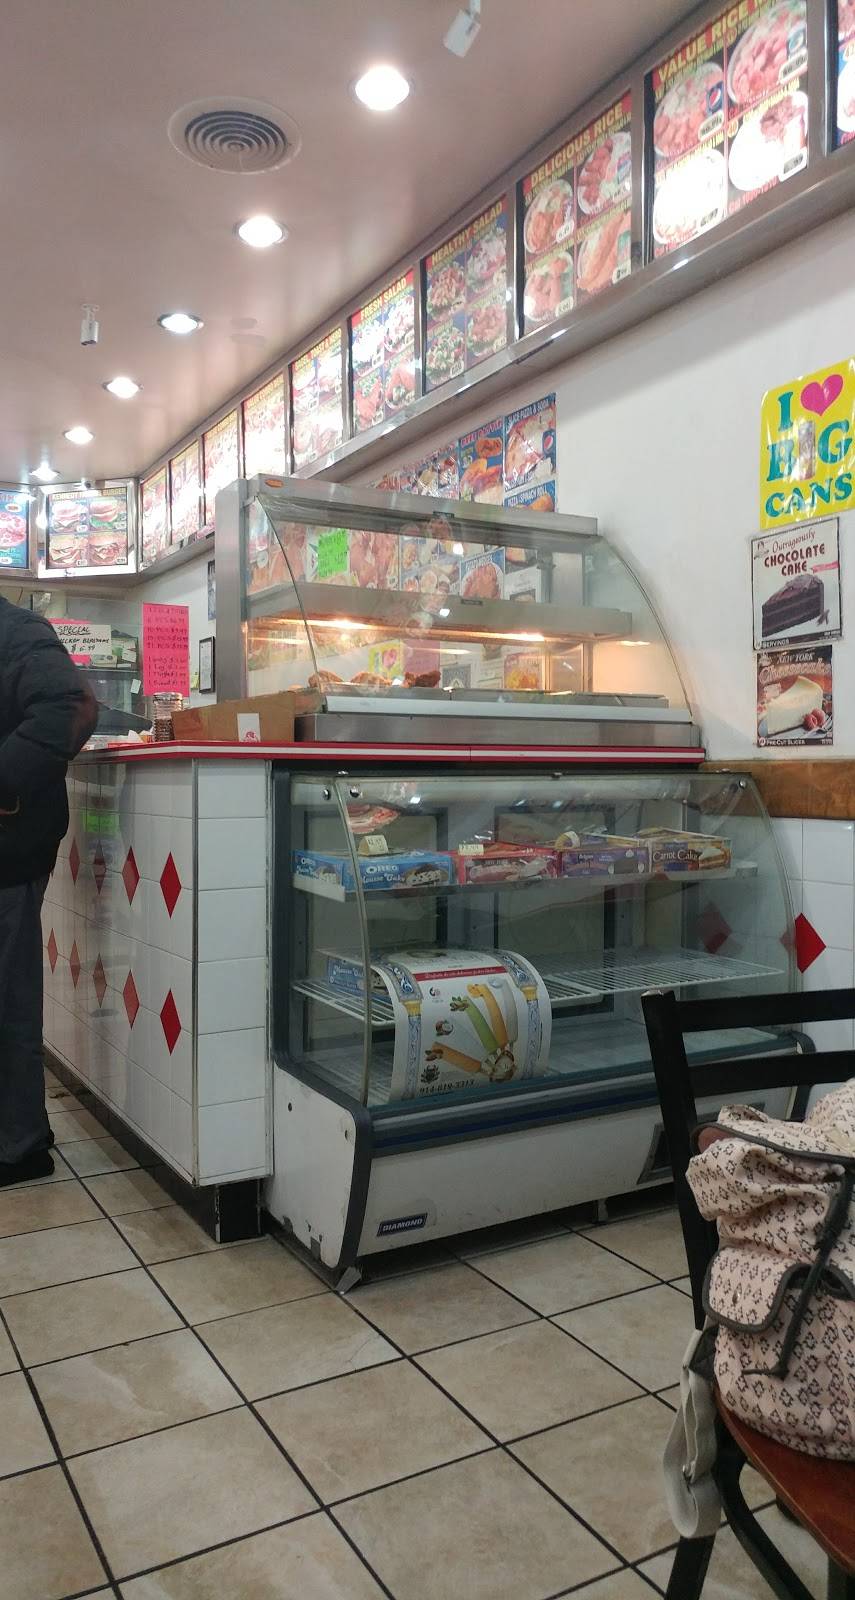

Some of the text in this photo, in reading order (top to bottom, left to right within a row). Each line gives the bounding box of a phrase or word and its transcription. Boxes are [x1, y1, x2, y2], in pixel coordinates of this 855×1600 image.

[657, 34, 705, 82] VALUE
[711, 1, 748, 40] RICE
[530, 129, 590, 187] DELICIOUS
[594, 101, 623, 137] RICE
[431, 202, 502, 266] HEALTHY SALAD
[360, 277, 407, 321] FRESH SALAD
[778, 391, 794, 432] I
[765, 472, 852, 517] CANS
[764, 543, 825, 568] CHOCOLATE
[772, 527, 815, 554] Outrageously
[781, 560, 807, 577] CAKE
[366, 865, 399, 874] OREO
[653, 851, 676, 863] Carrot
[382, 1218, 423, 1232] DIAMOND
